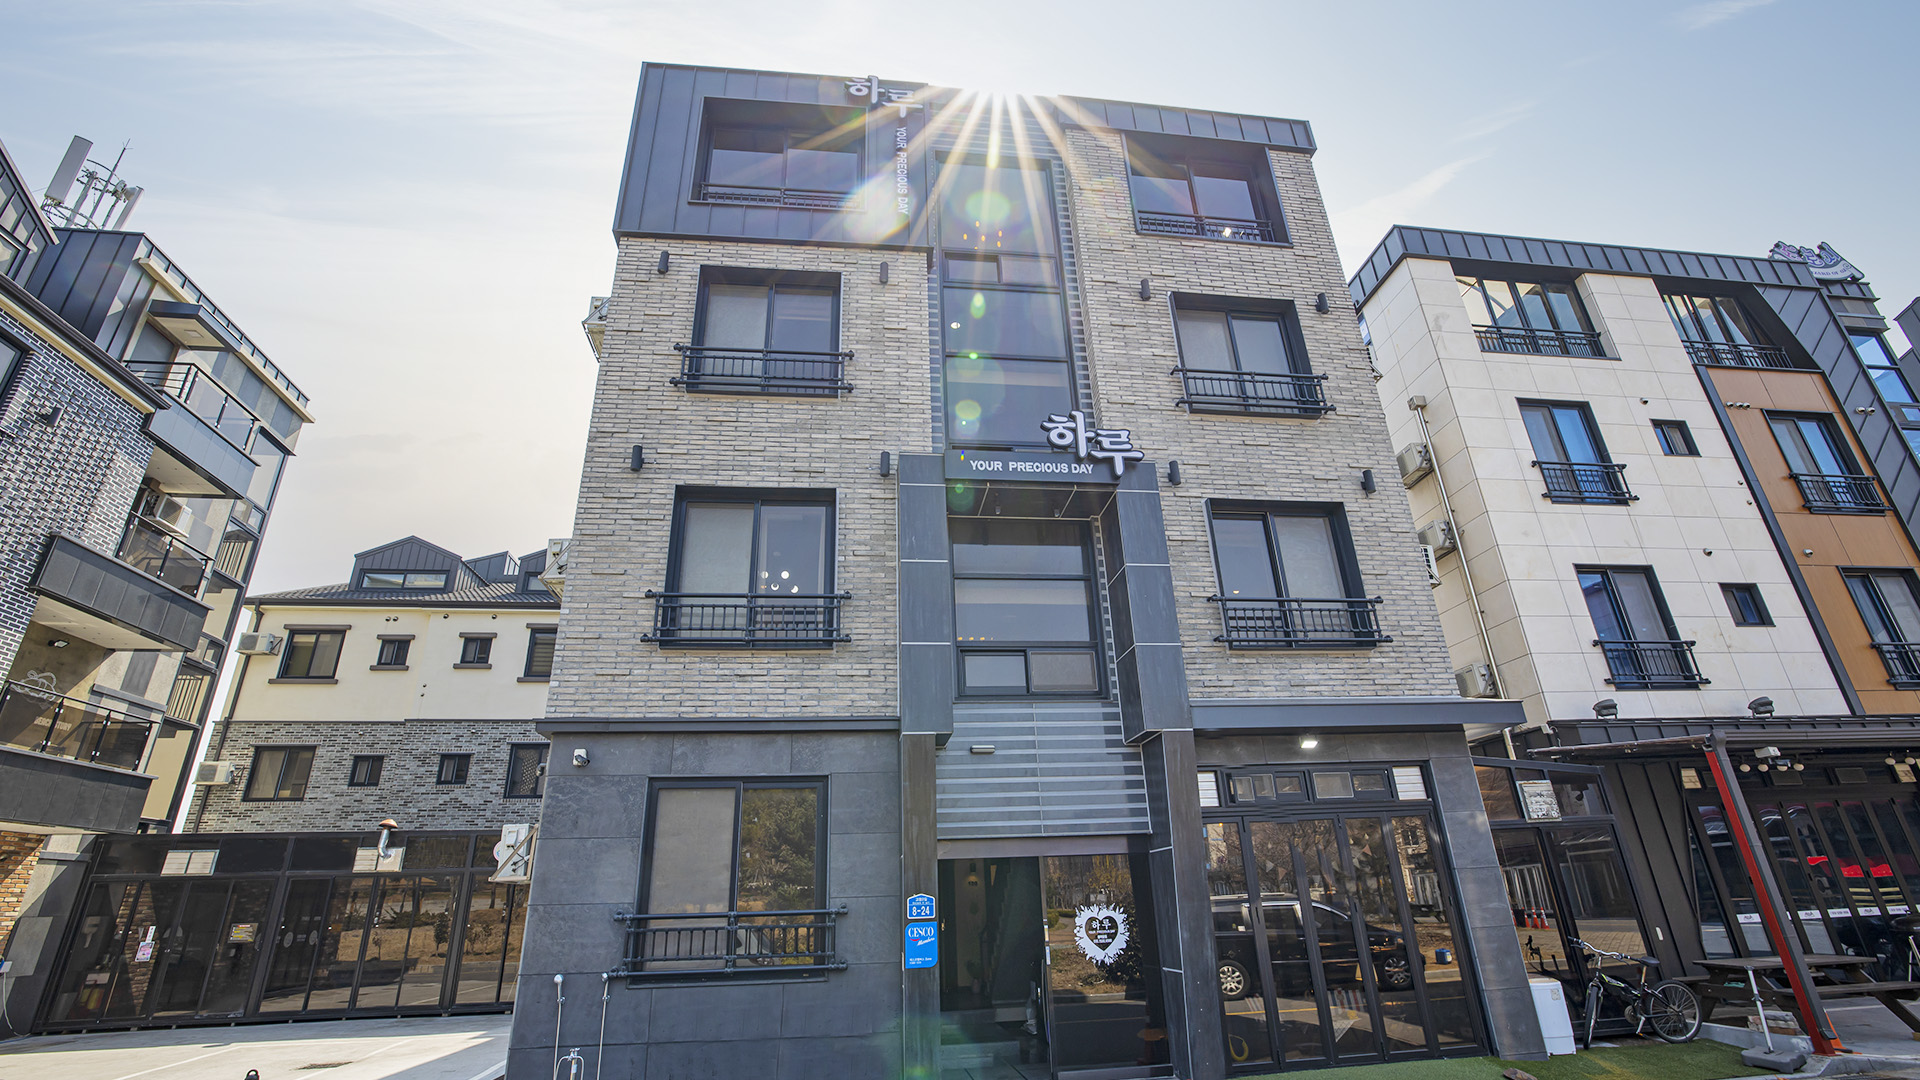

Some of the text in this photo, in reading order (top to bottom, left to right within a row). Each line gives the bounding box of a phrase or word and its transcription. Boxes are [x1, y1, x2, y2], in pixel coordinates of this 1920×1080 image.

[845, 75, 923, 118] 하루
[897, 127, 909, 215] YOUR PRECIOUS DAY
[1040, 410, 1145, 477] 하루
[970, 460, 1094, 474] YOUR PRECIOUS DAY
[912, 906, 930, 916] 8-24
[908, 927, 934, 938] CESCO
